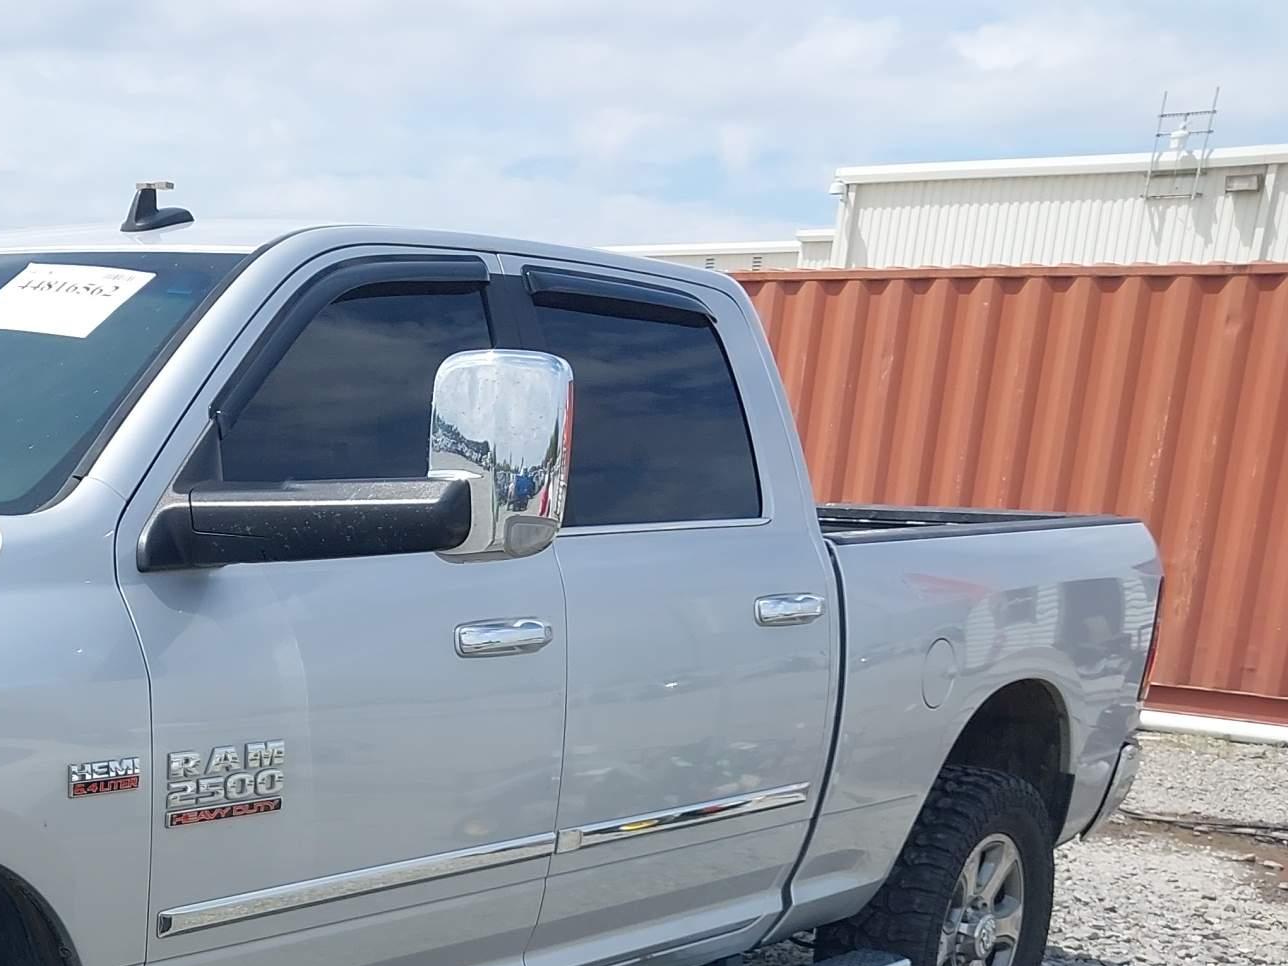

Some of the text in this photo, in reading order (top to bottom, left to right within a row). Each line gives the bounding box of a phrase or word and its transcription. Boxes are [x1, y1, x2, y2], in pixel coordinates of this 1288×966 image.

[18, 280, 120, 297] 44816562
[70, 757, 141, 781] HEMI
[168, 740, 285, 778] RAM
[99, 776, 138, 792] LITER
[167, 769, 284, 808] 2500
[172, 799, 279, 826] HEAVY DUTY
